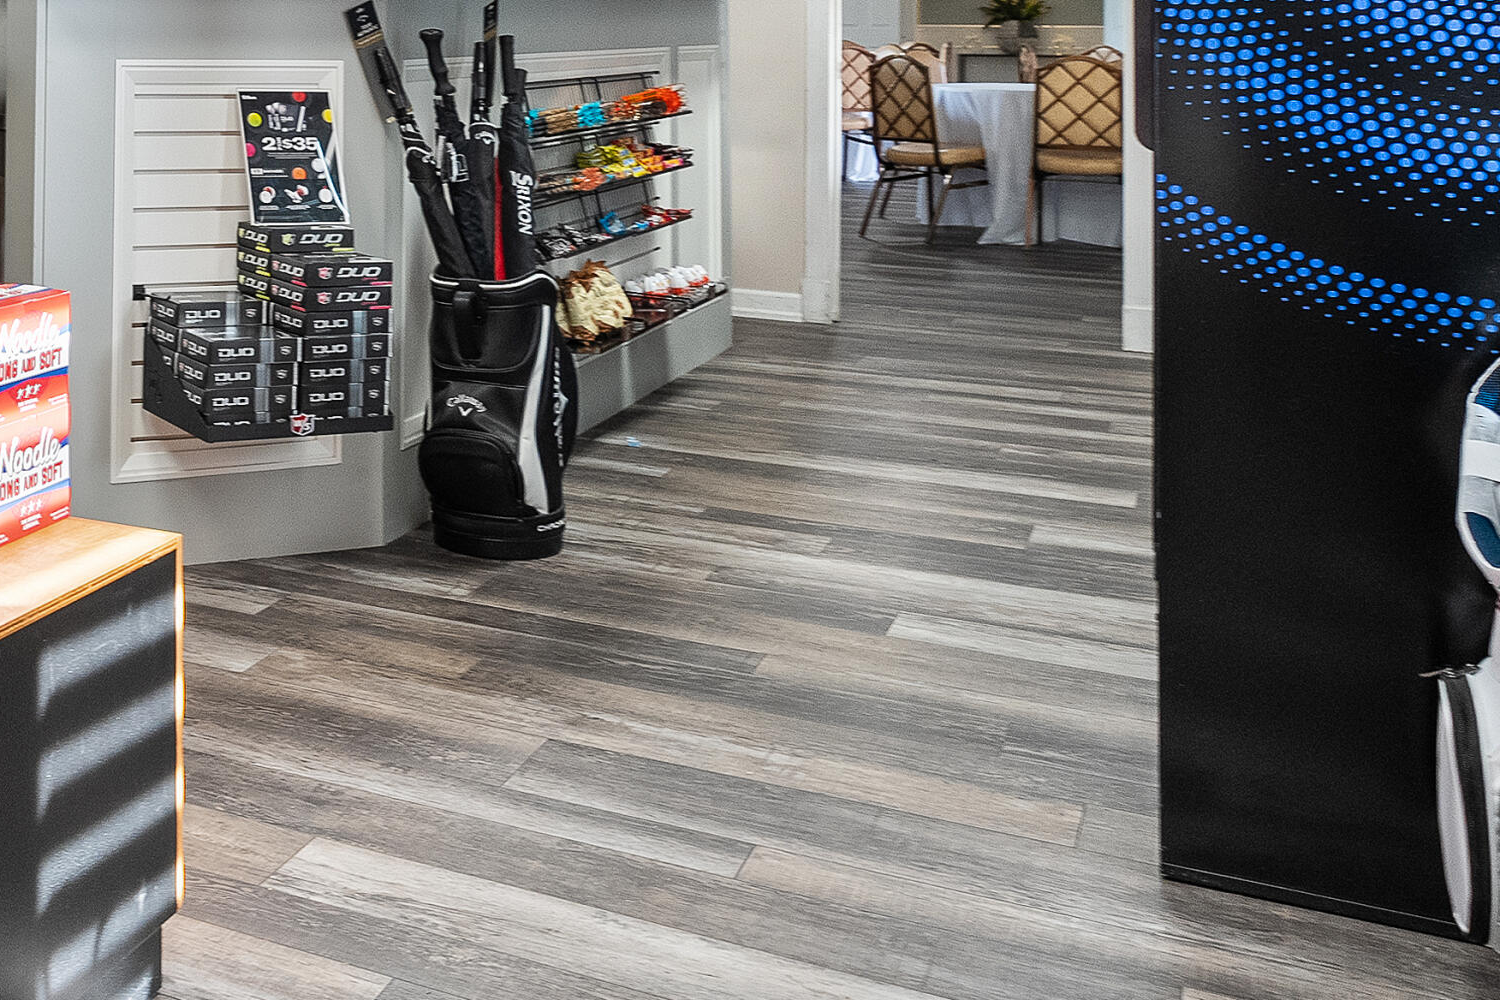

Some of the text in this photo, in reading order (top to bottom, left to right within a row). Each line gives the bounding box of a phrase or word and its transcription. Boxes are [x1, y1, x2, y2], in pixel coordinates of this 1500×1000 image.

[261, 136, 277, 151] 2
[509, 170, 534, 236] SRIXON
[244, 230, 268, 243] DUO
[299, 233, 344, 244] DUO
[244, 253, 268, 267] DUO
[279, 263, 305, 277] DUO
[336, 266, 382, 278] DUO
[243, 276, 268, 291] DUO
[278, 287, 304, 301] DUO
[335, 291, 381, 302] DUO
[185, 309, 221, 319] DUO
[314, 318, 349, 329] DUO
[218, 347, 255, 358] DUO
[311, 343, 348, 354] DUO
[21, 356, 37, 373] AND
[39, 348, 63, 369] SOFT
[214, 371, 251, 382] DUO
[310, 367, 346, 378] DUO
[212, 396, 250, 407] DUO
[309, 391, 345, 402] DUO
[23, 474, 39, 493] AND
[41, 461, 63, 484] SOFT
